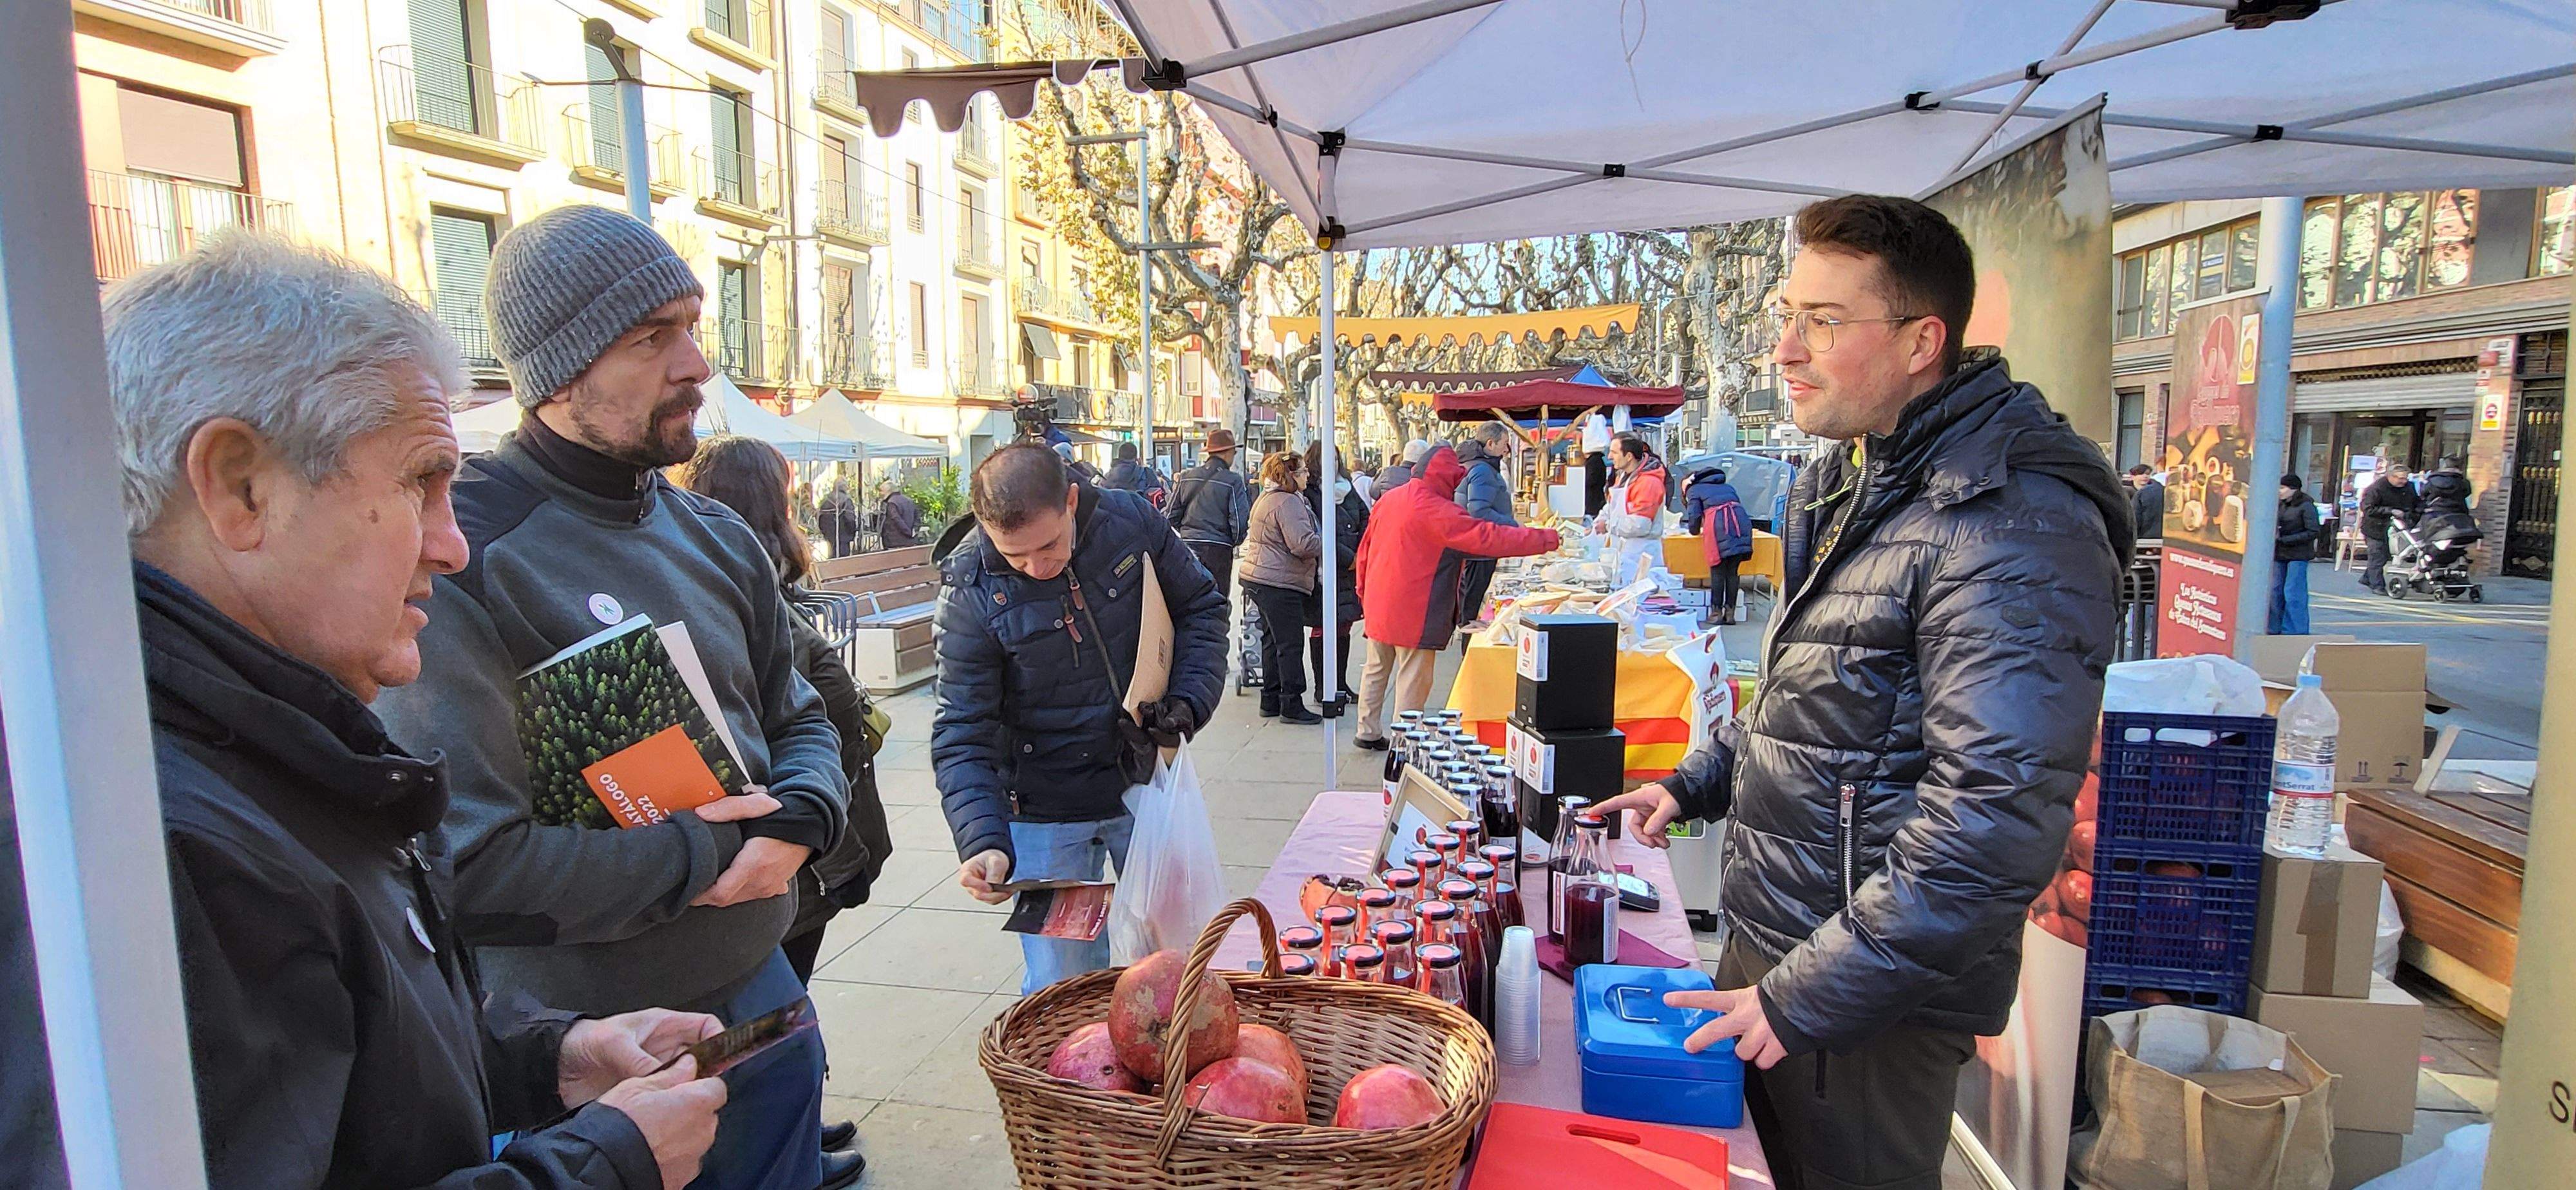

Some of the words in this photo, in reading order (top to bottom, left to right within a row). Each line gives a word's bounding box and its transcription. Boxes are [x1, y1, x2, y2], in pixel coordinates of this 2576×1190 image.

[600, 773, 648, 827] ATÁLOGO
[2275, 781, 2315, 791] ontSerrat
[637, 795, 664, 824] 2022
